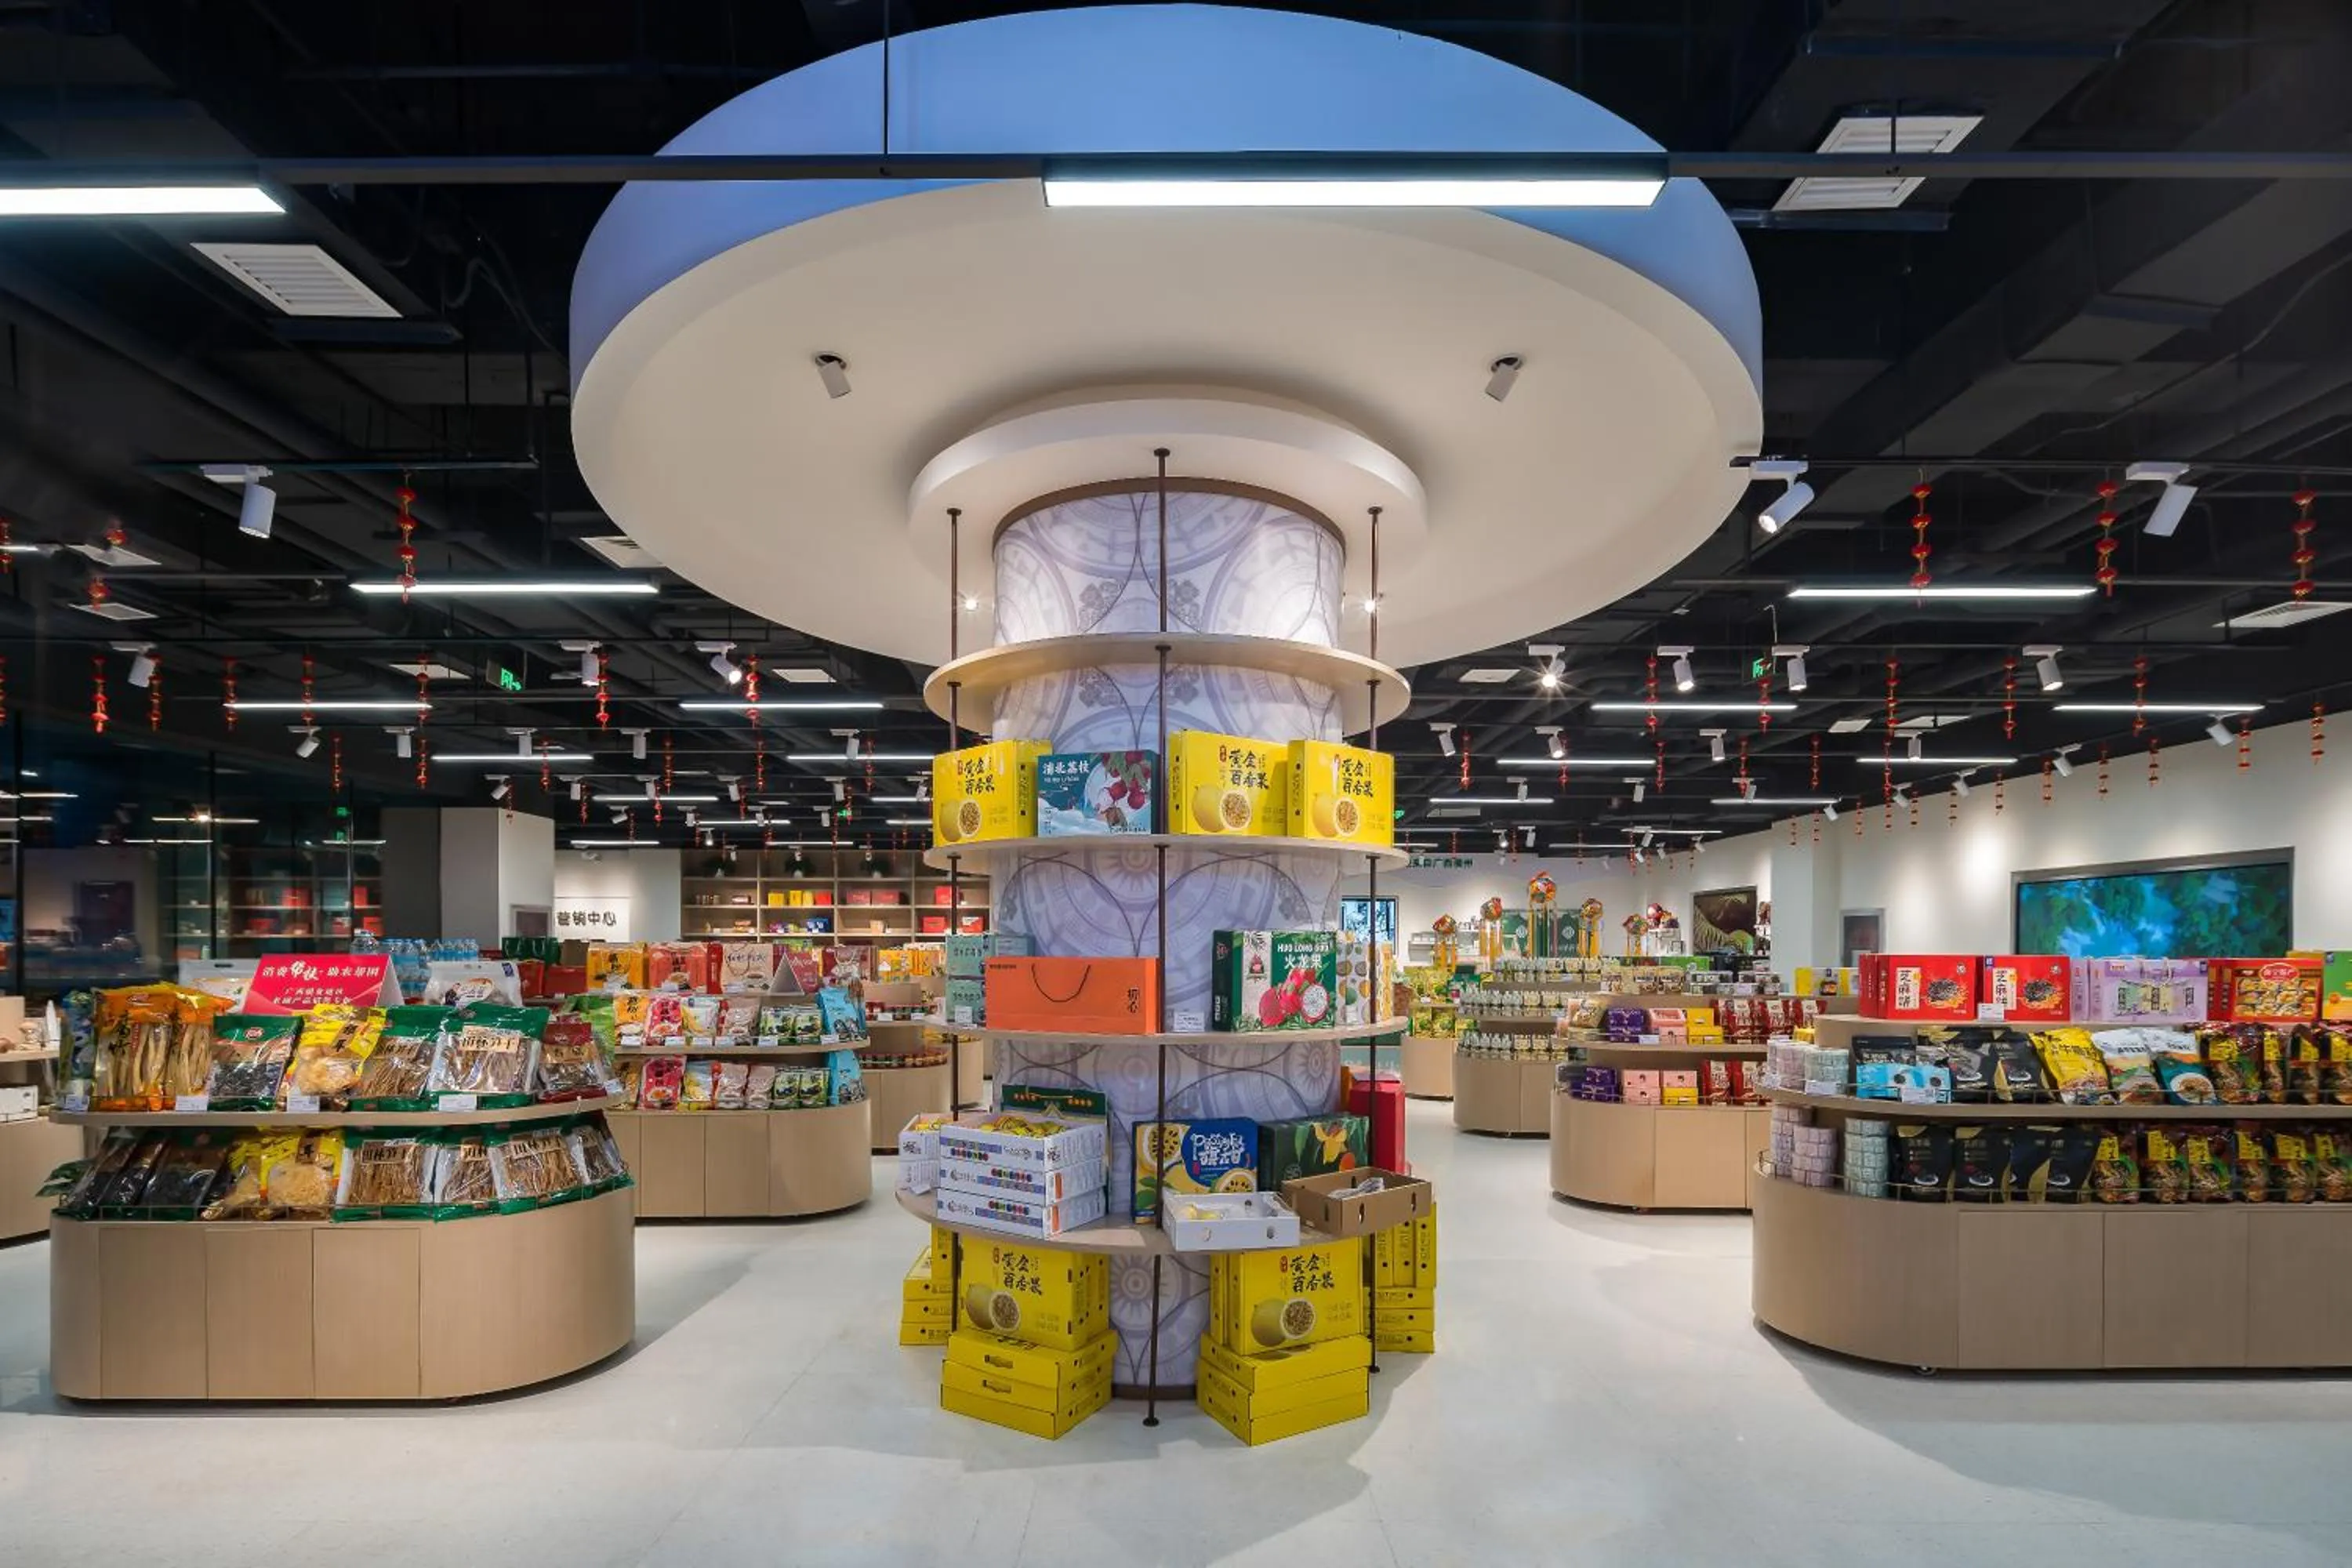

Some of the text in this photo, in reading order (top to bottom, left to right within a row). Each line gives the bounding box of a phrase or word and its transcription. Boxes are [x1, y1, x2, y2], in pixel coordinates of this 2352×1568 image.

[557, 911, 617, 926] 营销中心
[1284, 953, 1323, 969] 火龙果
[1002, 1252, 1030, 1273] 黄金
[1290, 1254, 1320, 1276] 黄金
